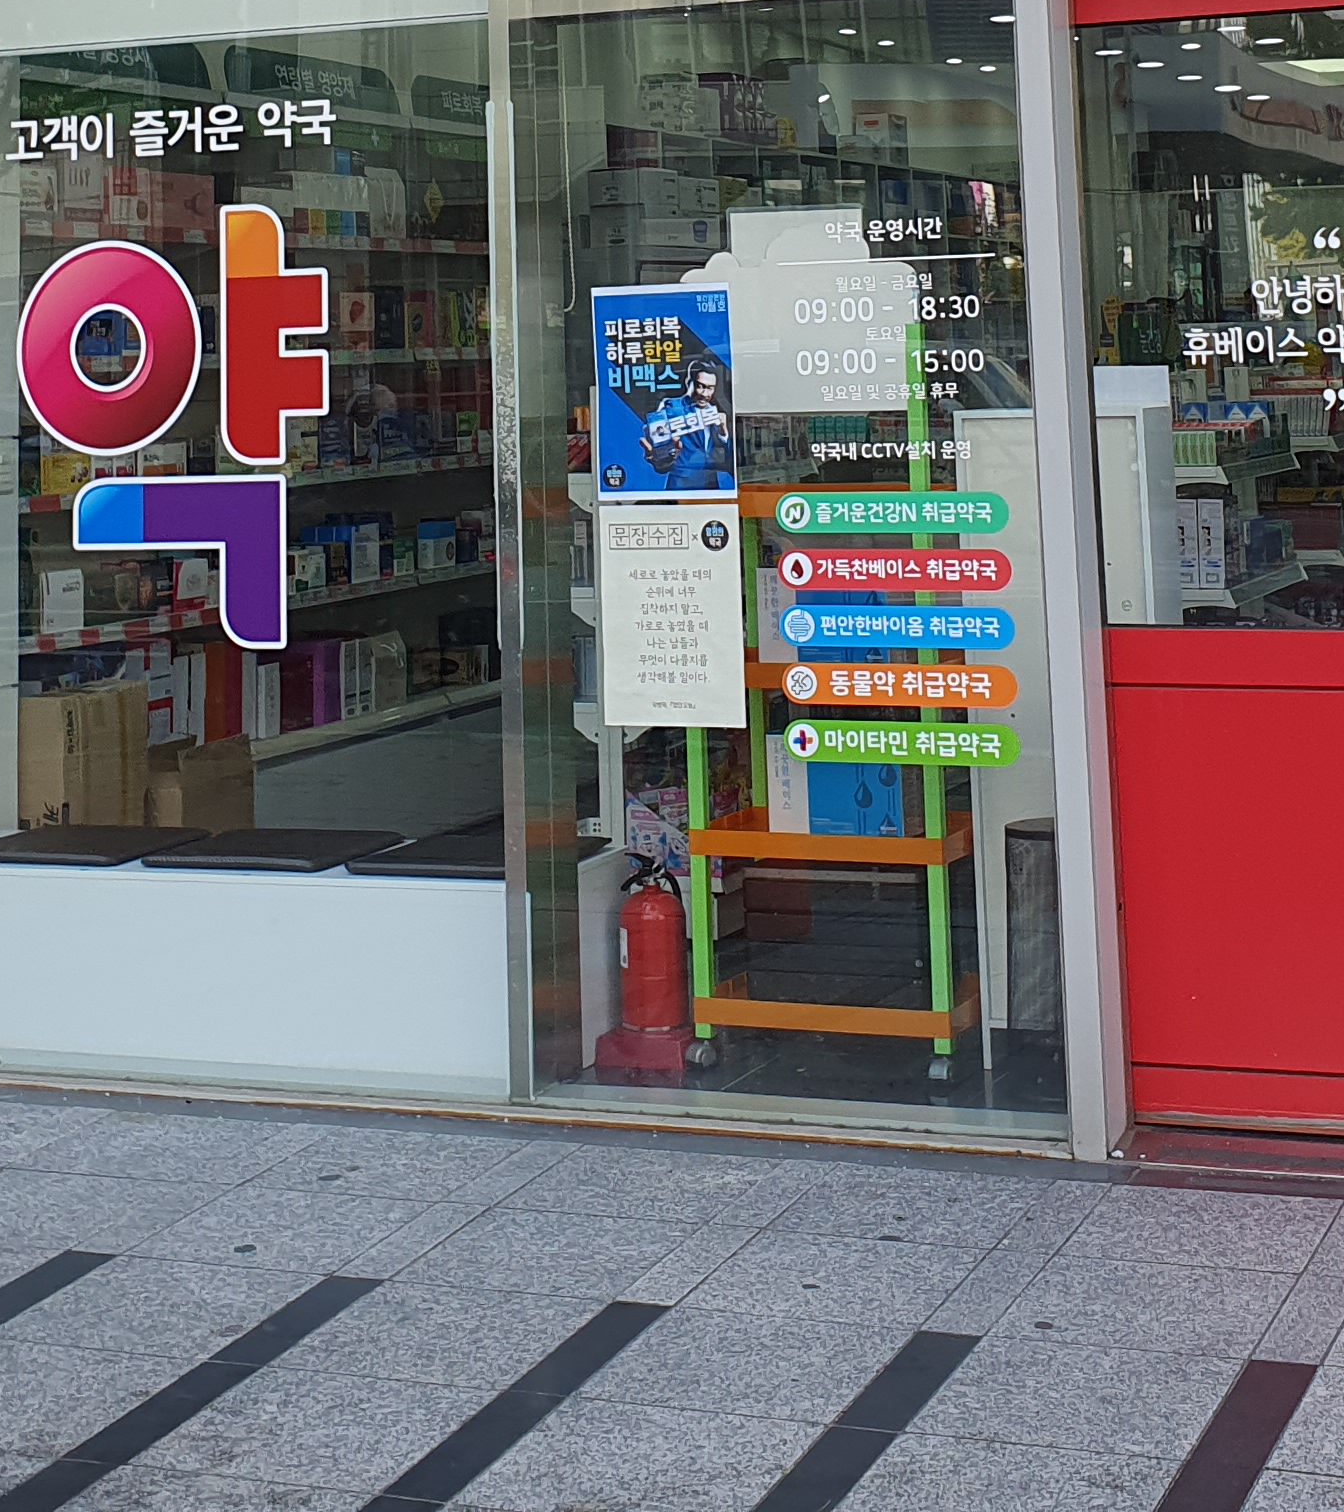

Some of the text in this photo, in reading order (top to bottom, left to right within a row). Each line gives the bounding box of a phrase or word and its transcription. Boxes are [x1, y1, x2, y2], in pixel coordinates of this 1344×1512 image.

[4, 97, 338, 163] 고객이 즐거운 약국
[824, 215, 944, 244] 약국 운영시간
[834, 274, 878, 294] 월요일
[889, 272, 934, 292] 금요일
[793, 295, 875, 325] 09:00
[907, 294, 981, 323] 18:30
[603, 317, 682, 341] 피로회복
[864, 325, 907, 342] 토요일
[1182, 325, 1309, 366] 휴베이스
[795, 347, 878, 377] 09:00
[910, 348, 985, 374] 15:00
[608, 364, 682, 395] 비맥스
[819, 384, 863, 403] 일요일
[883, 382, 928, 402] 공휴일
[929, 381, 960, 401] 휴무
[16, 203, 331, 651] 약
[810, 441, 858, 462] 약국내
[939, 439, 973, 460] 운영
[814, 501, 994, 525] 즐거운건강N 취급약국
[611, 525, 684, 548] 문장수집
[816, 558, 998, 582] 가득찬베이스 취급약국
[819, 614, 1001, 638] 편안한바이옴 취급약국
[829, 670, 993, 700] 동물약 취급약국
[823, 729, 1003, 759] 마이타민 취급약국
